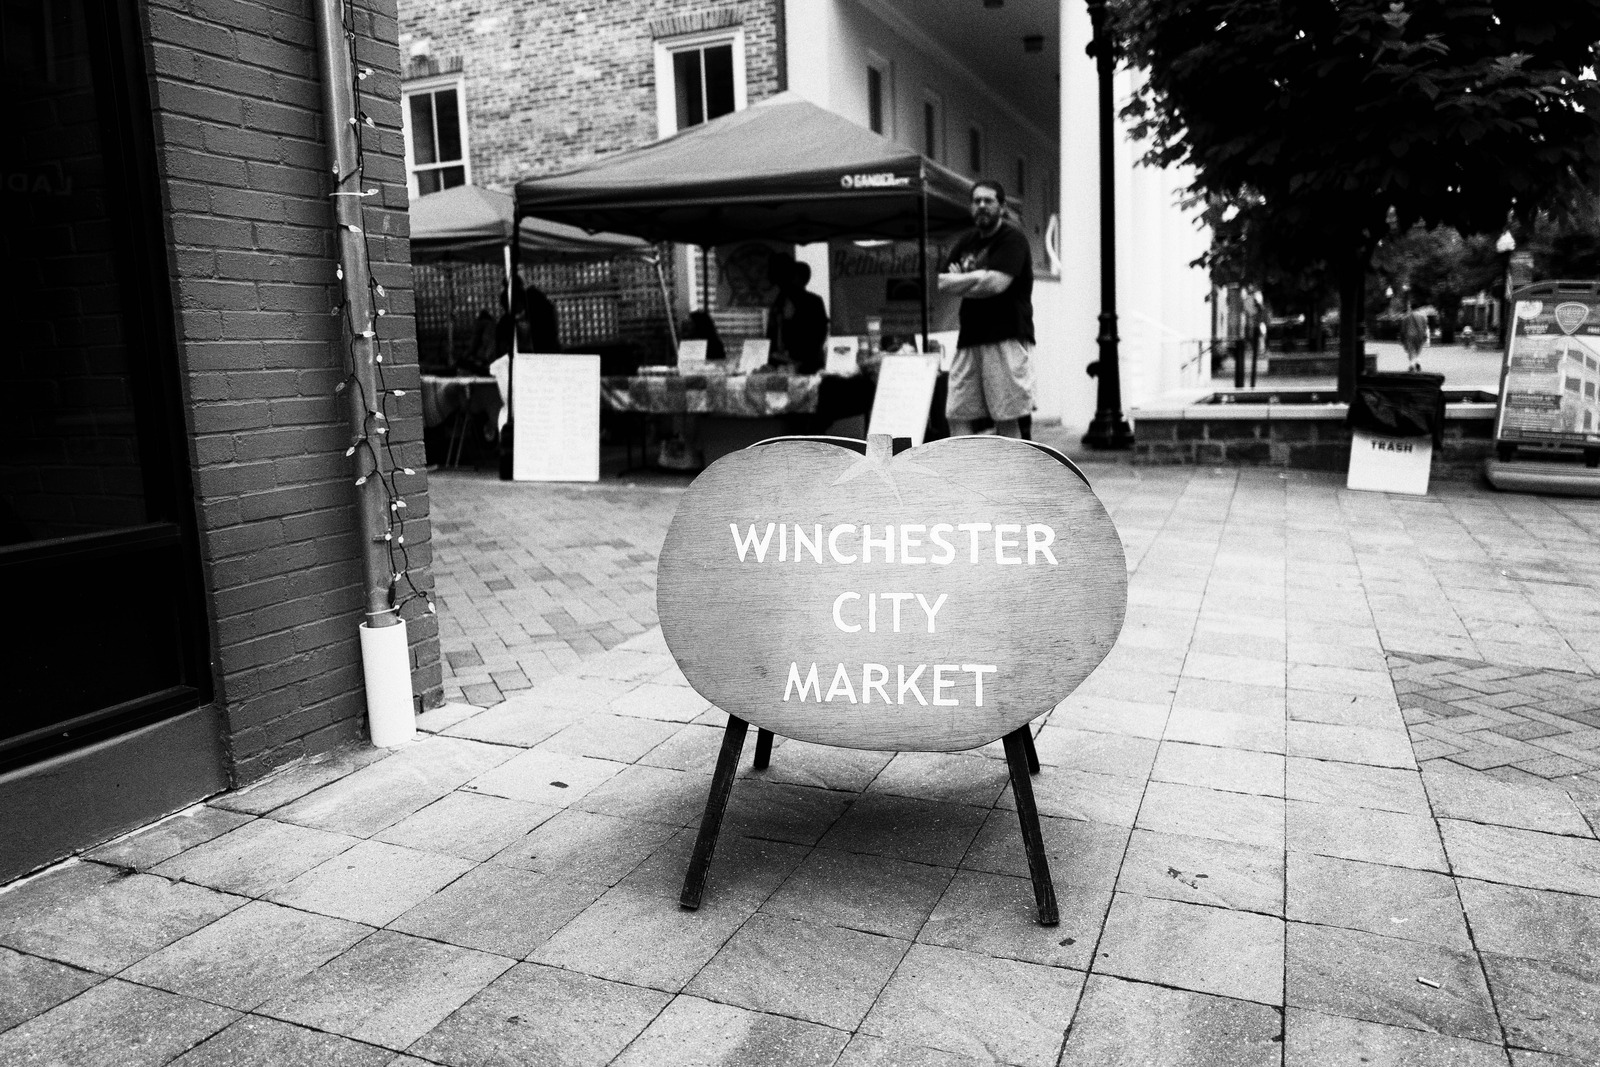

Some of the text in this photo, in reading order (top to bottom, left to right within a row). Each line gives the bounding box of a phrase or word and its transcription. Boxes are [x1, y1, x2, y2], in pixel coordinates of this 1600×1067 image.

[1371, 440, 1413, 454] TRASH
[729, 522, 1058, 566] WINCHESTER
[832, 591, 949, 634] CITY
[783, 662, 997, 707] MARKET
